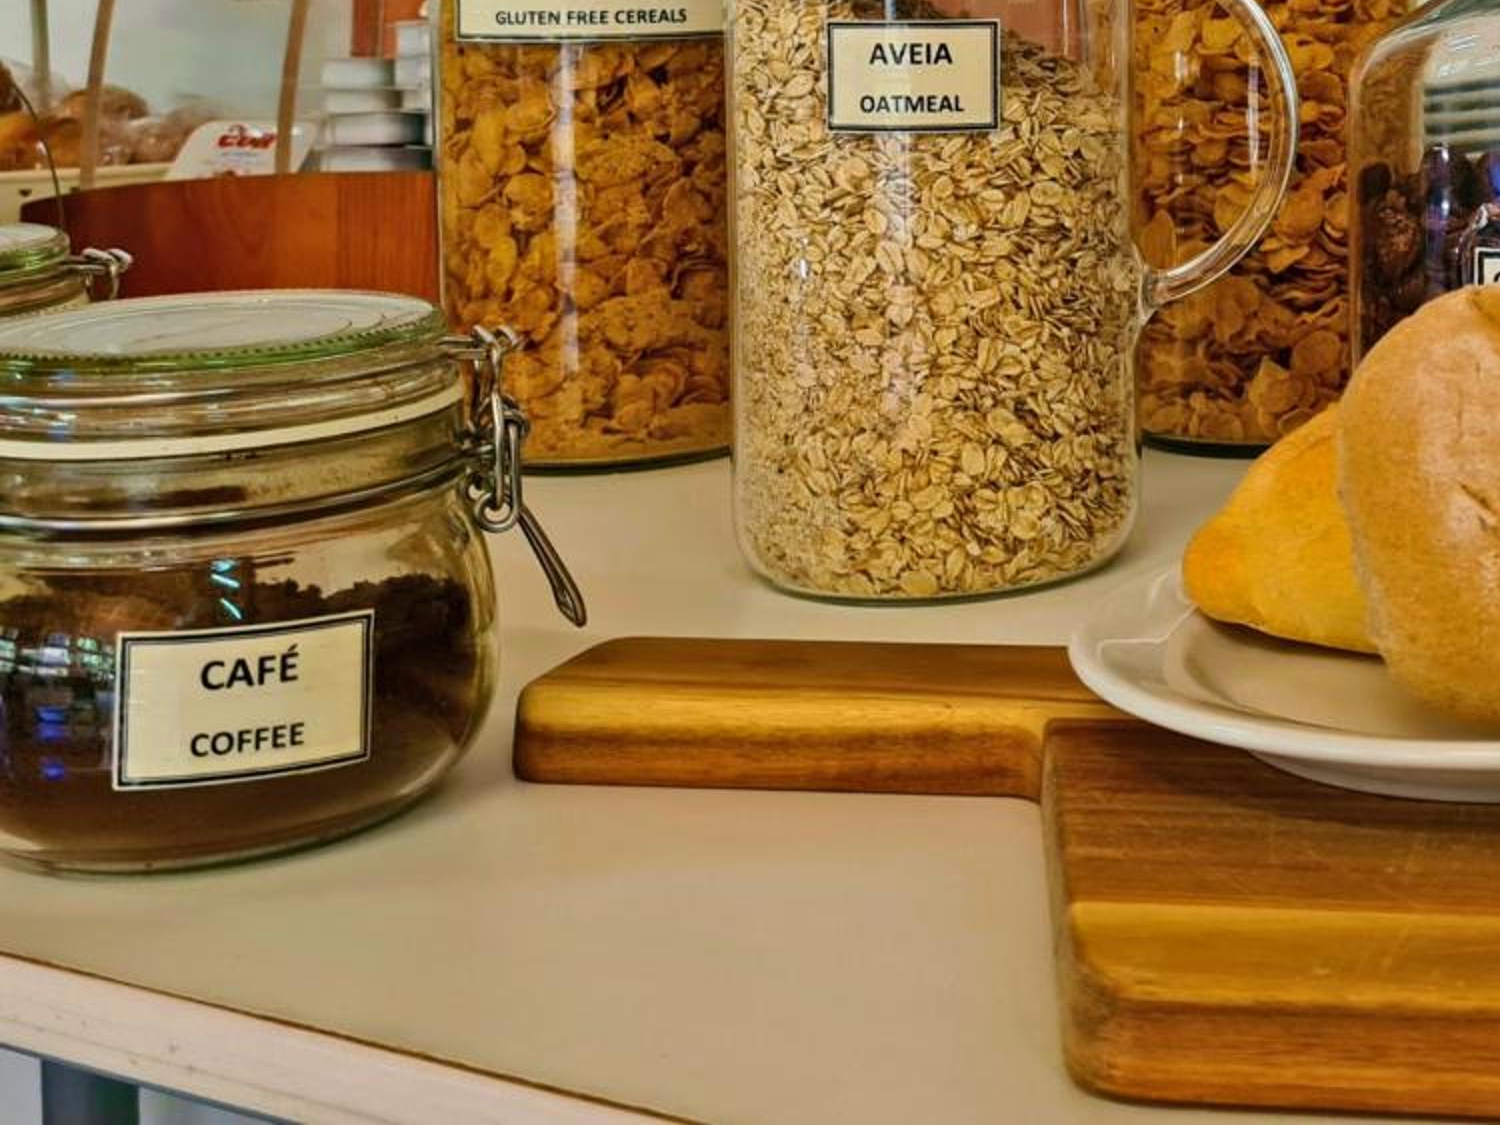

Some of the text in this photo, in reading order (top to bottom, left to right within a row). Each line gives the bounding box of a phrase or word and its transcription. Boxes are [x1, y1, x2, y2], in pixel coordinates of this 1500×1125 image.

[495, 9, 687, 25] GLUTEN FREE CEREALS
[869, 42, 953, 65] AVEIA
[859, 94, 964, 113] OATMEAL
[200, 643, 299, 690] CAFÉ
[190, 722, 305, 757] COFFEE
